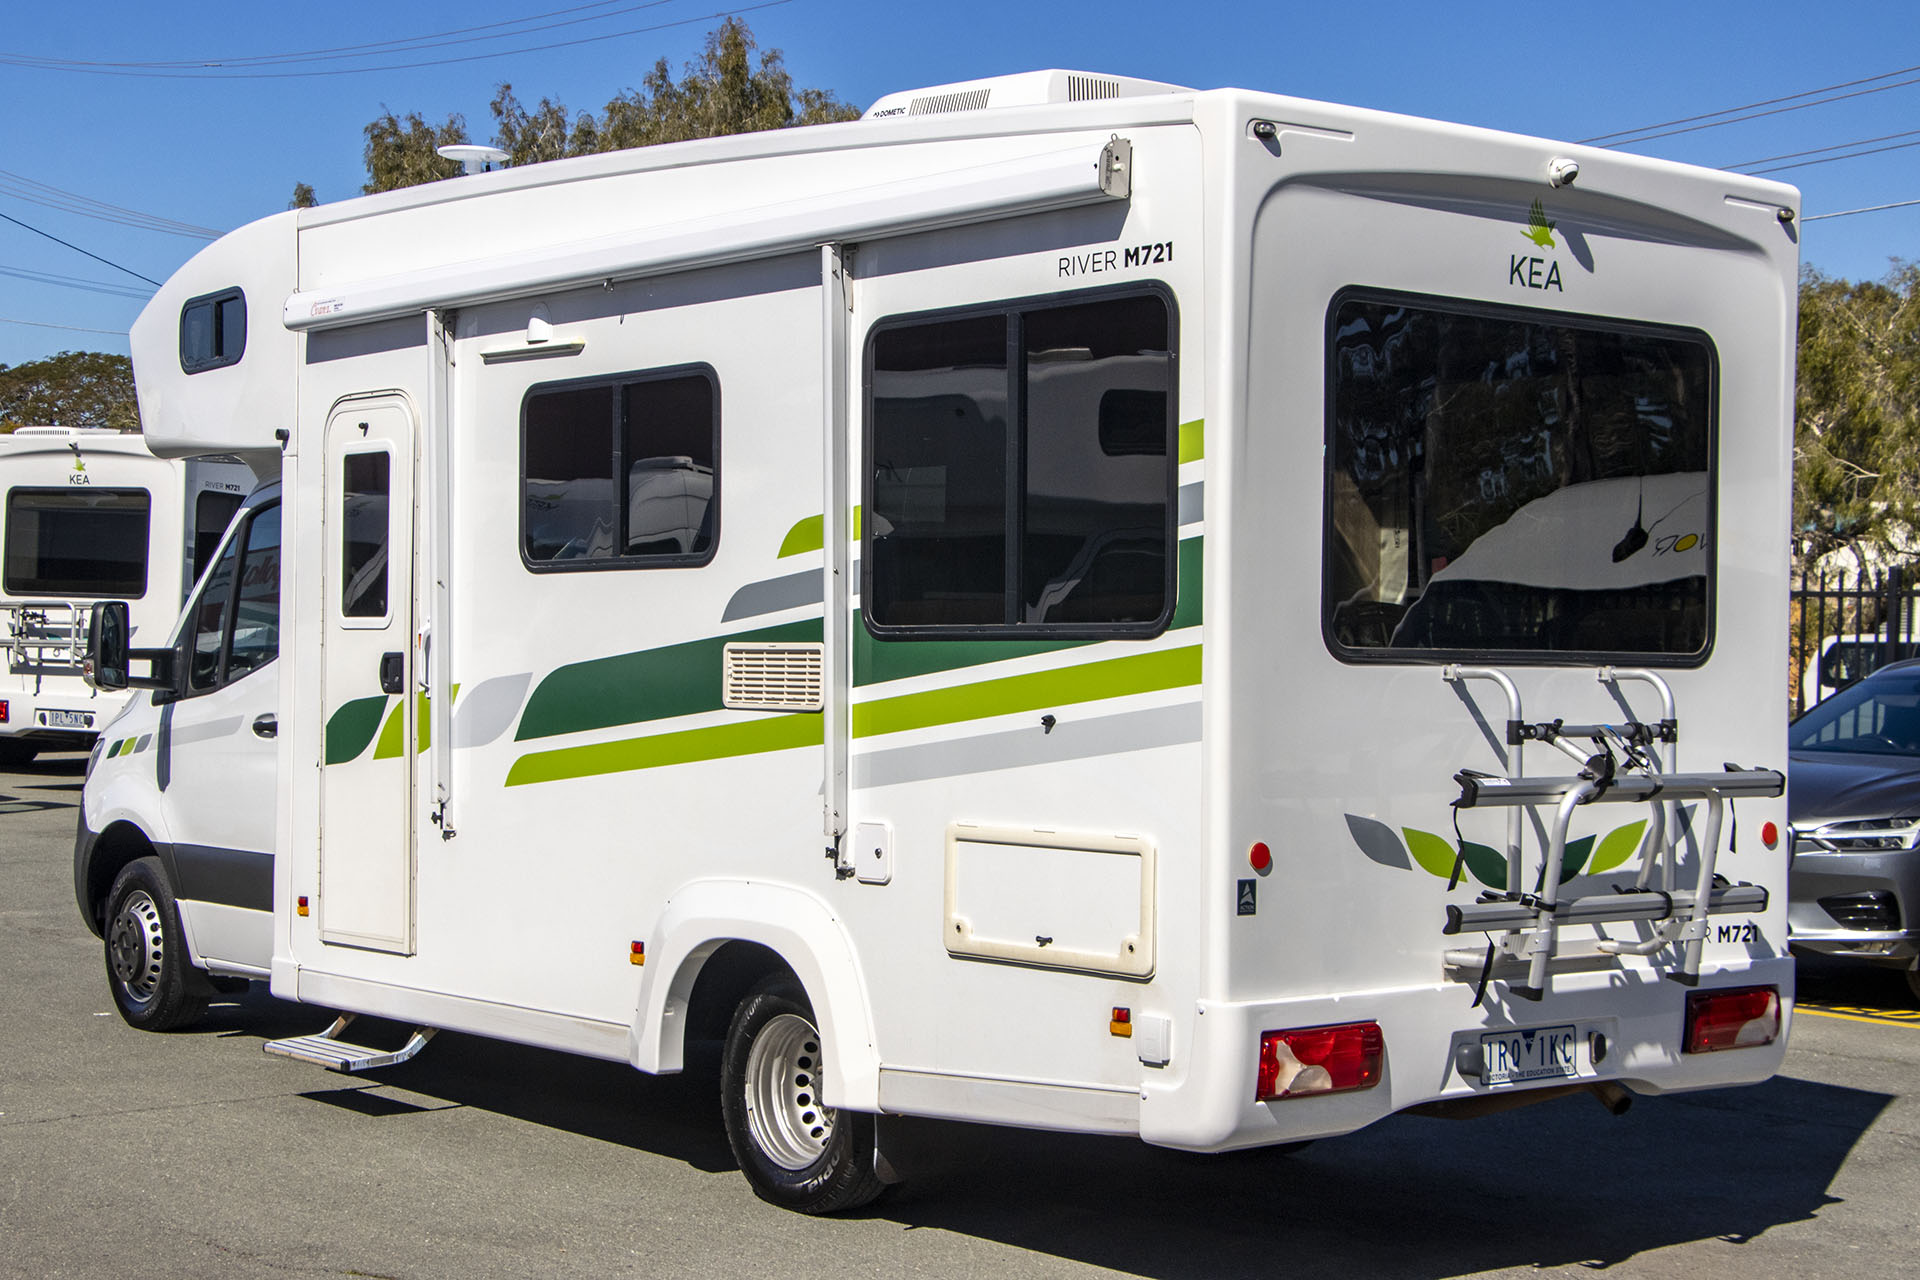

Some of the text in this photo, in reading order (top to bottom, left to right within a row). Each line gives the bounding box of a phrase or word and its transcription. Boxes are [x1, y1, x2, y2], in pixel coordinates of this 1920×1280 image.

[1058, 240, 1173, 278] RIVER M721
[1509, 254, 1563, 292] KEA
[69, 474, 90, 485] KEA
[204, 480, 240, 492] RIVER M721
[1718, 925, 1758, 943] M721
[1540, 1033, 1572, 1066] 1KC
